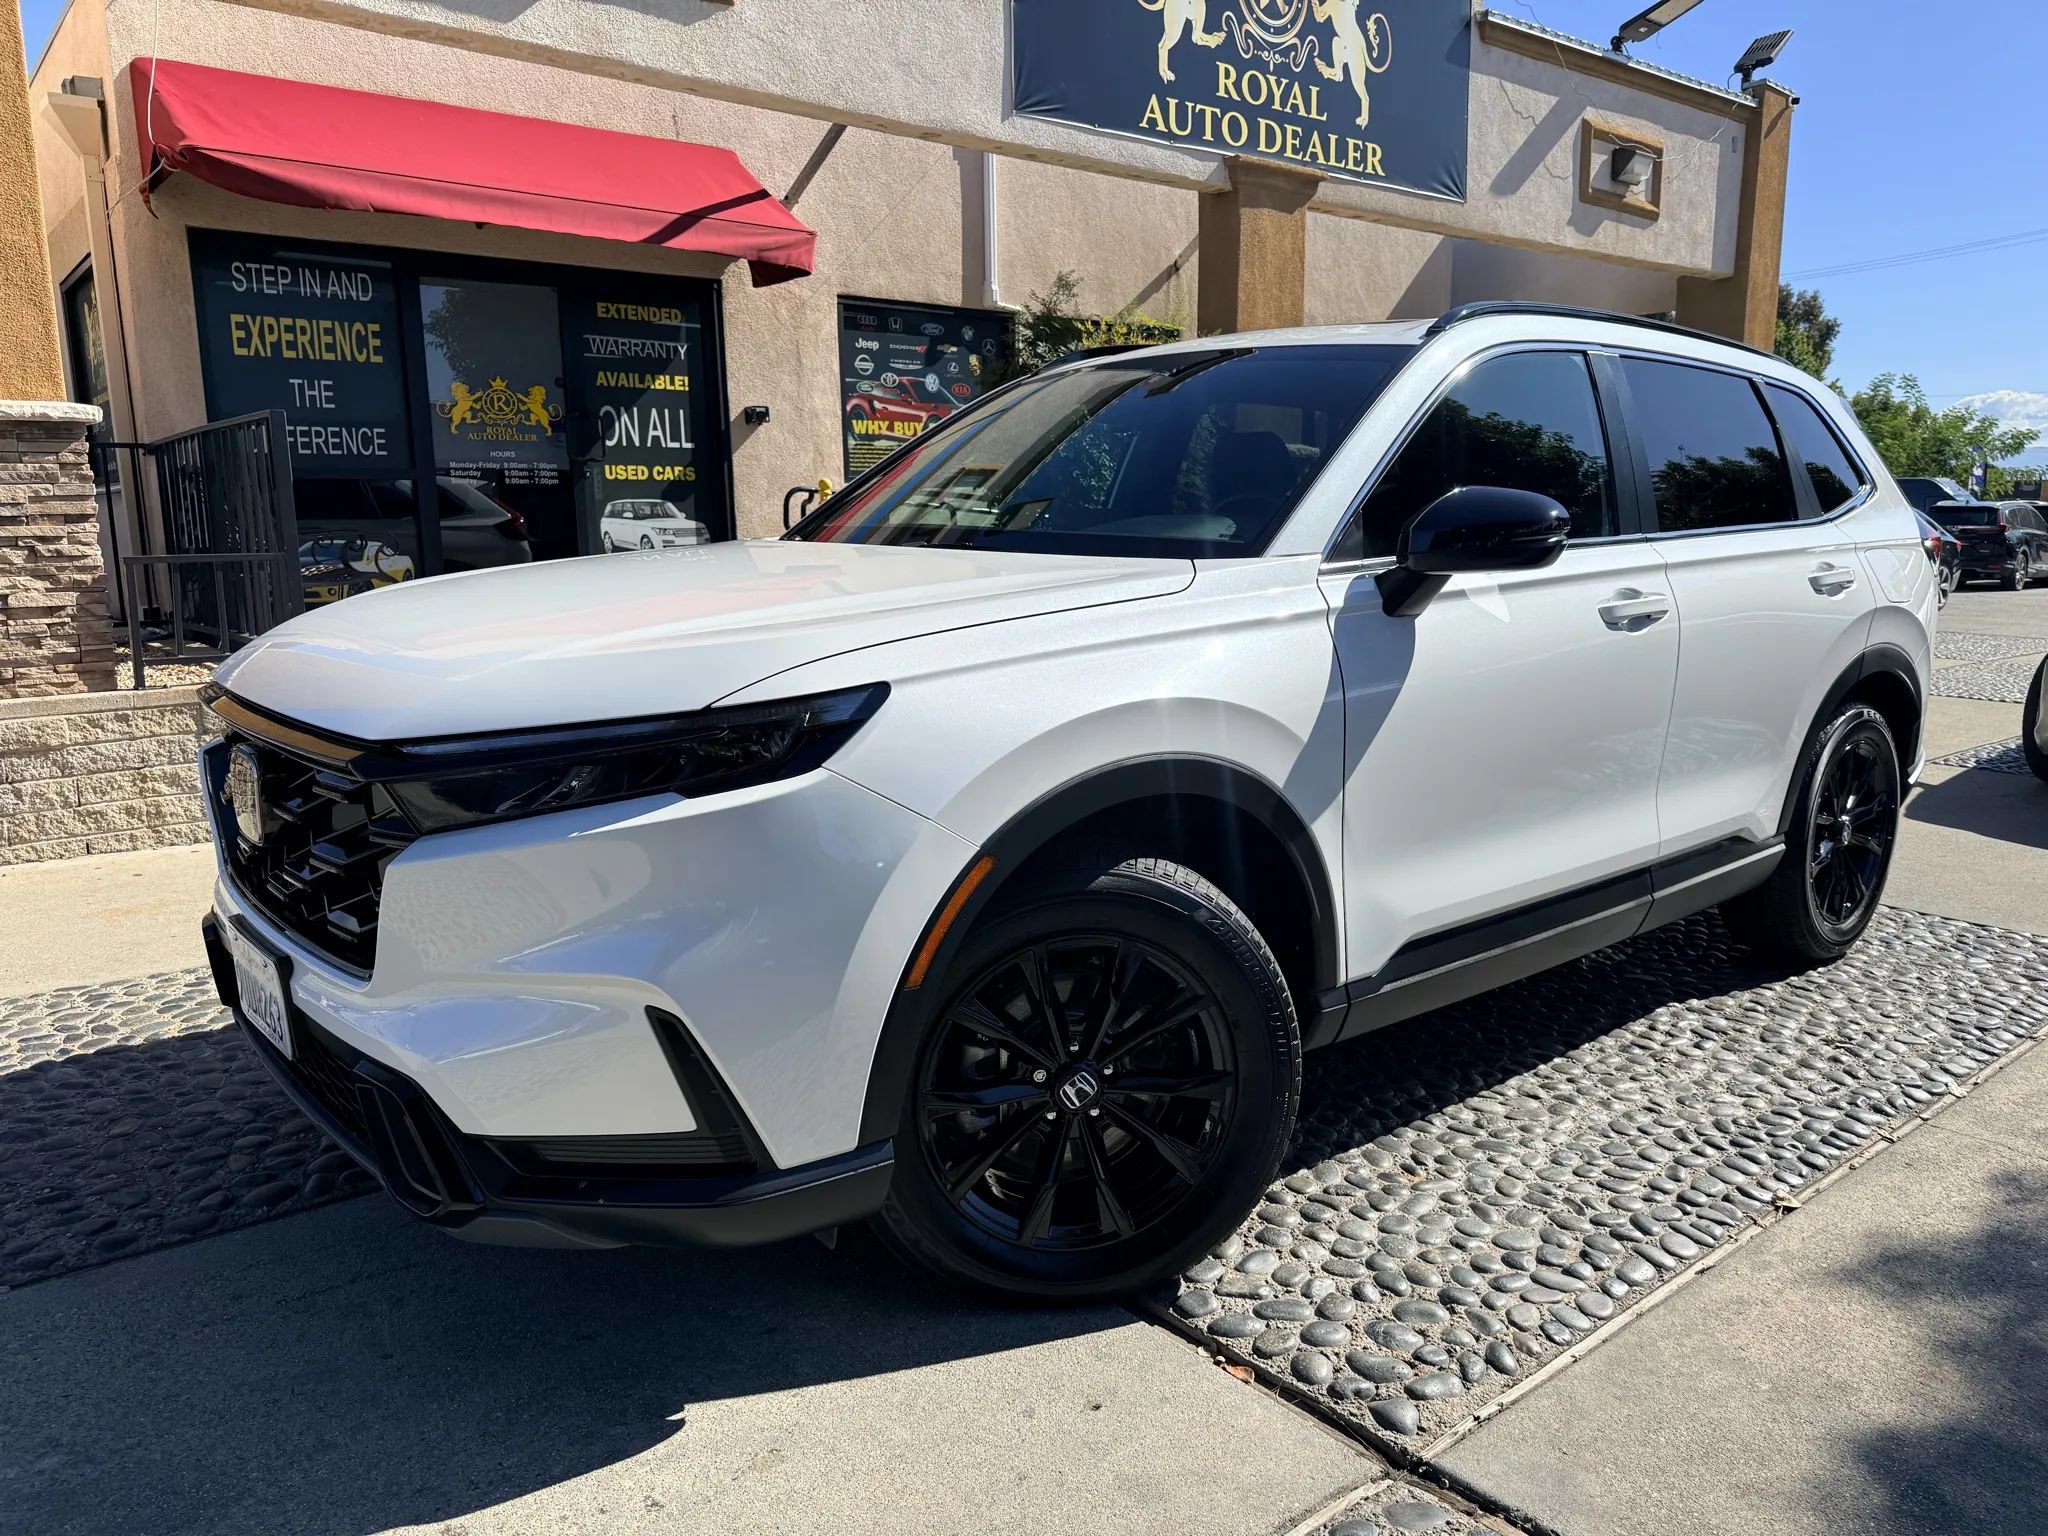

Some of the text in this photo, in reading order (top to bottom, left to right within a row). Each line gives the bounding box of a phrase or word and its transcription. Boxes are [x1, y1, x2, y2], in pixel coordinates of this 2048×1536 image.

[1215, 61, 1328, 122] ROYAL
[1138, 93, 1386, 177] AUTO DEALER
[231, 261, 373, 302] STEP IN AND
[596, 302, 682, 324] EXTENDED
[230, 313, 384, 364] EXPERIENCE
[588, 336, 688, 360] WARRANTY
[855, 337, 880, 351] Jeep
[596, 371, 689, 391] AVAILABLE!
[288, 378, 336, 408] THE
[467, 432, 538, 442] AUTO DEALER
[486, 426, 517, 434] ROYAL
[599, 405, 695, 449] ON ALL
[852, 419, 890, 435] WHY
[893, 421, 924, 436] BUY
[490, 450, 516, 458] HOURS
[449, 461, 500, 469] Monday-Friday
[450, 469, 481, 477] Saturday
[604, 464, 696, 481] USED CARS
